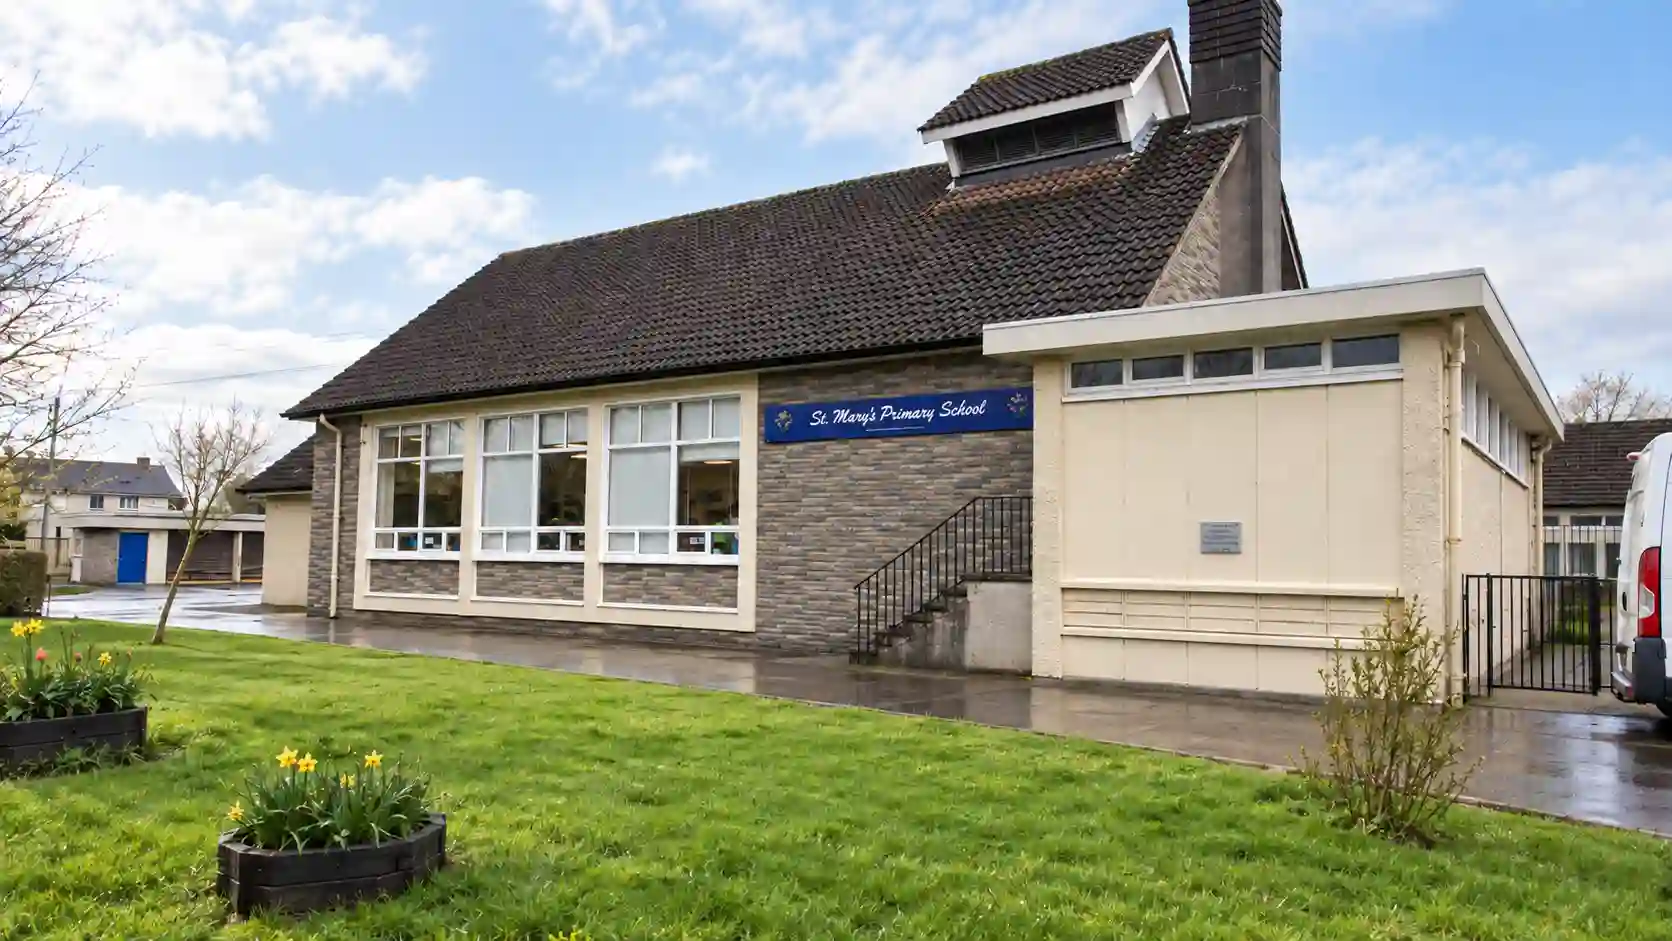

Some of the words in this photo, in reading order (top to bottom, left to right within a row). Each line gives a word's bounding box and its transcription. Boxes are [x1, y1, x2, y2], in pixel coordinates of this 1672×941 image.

[809, 410, 829, 426] St.
[832, 406, 876, 426] Mary's
[880, 404, 935, 423] Primary
[939, 399, 987, 417] School
